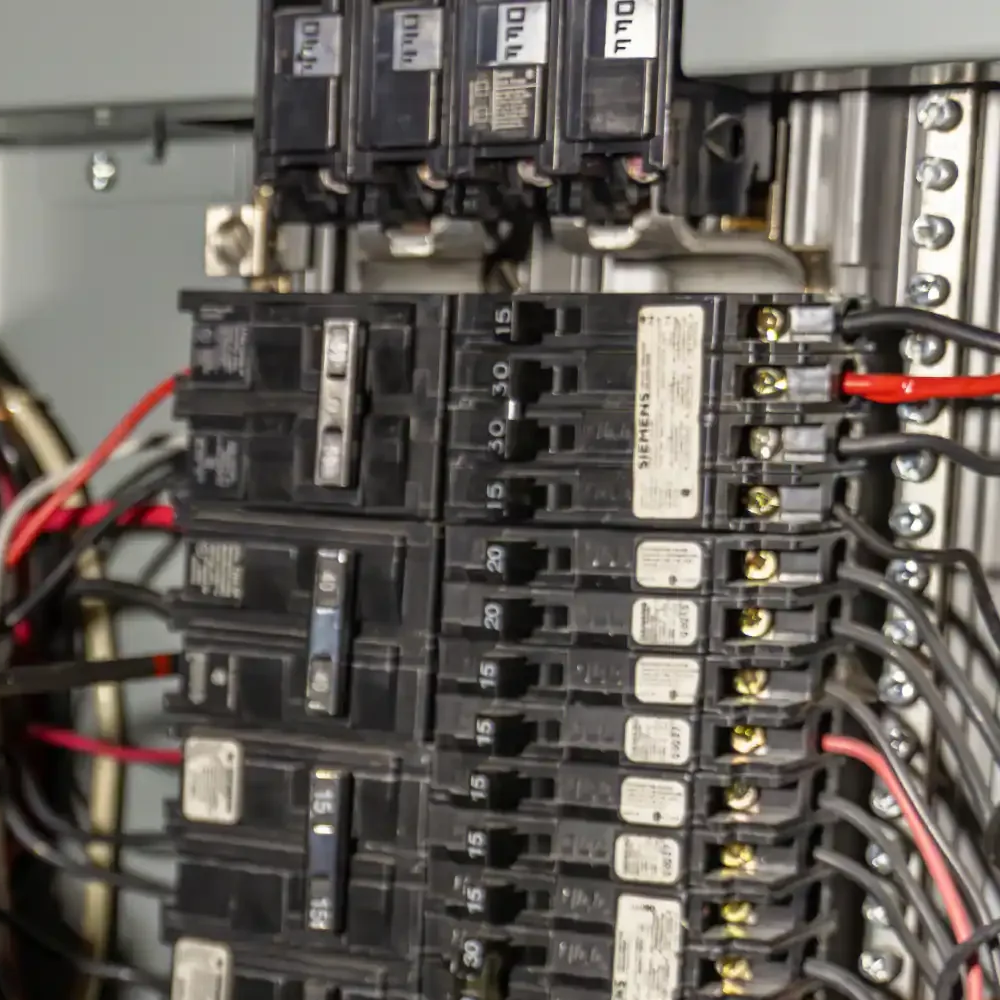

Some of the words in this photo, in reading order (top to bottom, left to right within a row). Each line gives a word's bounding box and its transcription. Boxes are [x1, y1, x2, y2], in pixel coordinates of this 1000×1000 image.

[506, 7, 525, 61] OFF
[615, 0, 636, 54] OFF
[495, 307, 511, 335] 15
[492, 361, 510, 397] 30
[488, 419, 506, 454] 30
[638, 392, 651, 470] SIEMENS
[486, 483, 505, 509] 15
[486, 544, 505, 573] 20
[484, 604, 503, 631] 20
[479, 661, 497, 689] 15
[476, 719, 494, 747] 15
[312, 789, 334, 815] 15
[470, 774, 489, 802] 15
[467, 831, 486, 859] 15
[466, 887, 485, 914] 15
[463, 939, 483, 969] 30
